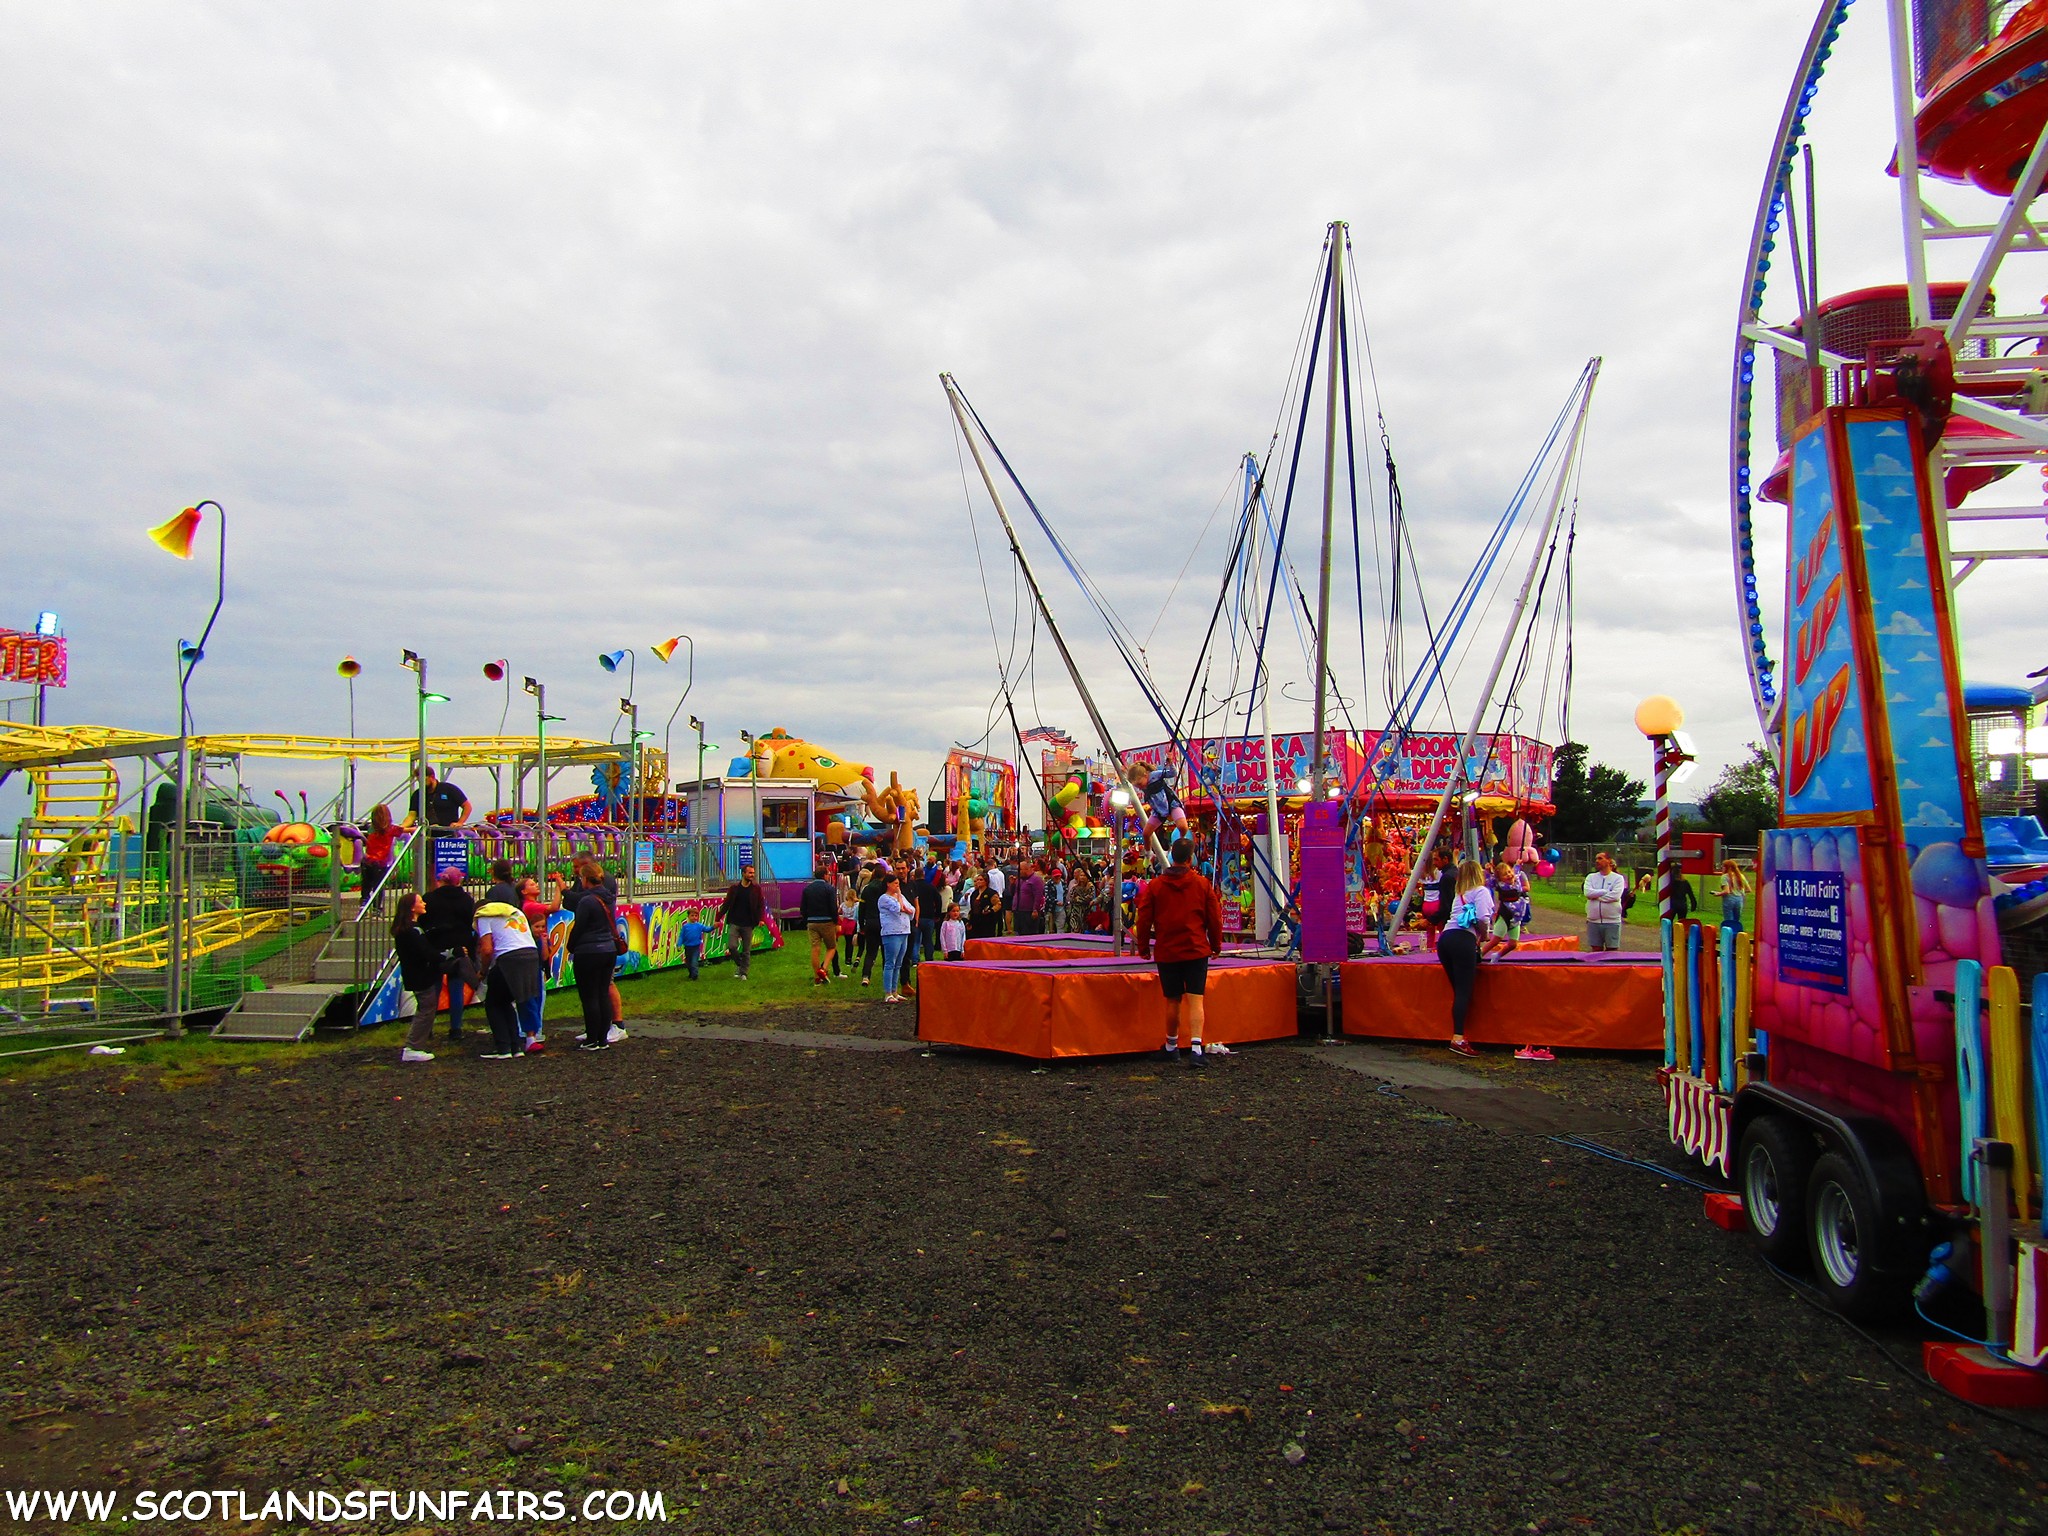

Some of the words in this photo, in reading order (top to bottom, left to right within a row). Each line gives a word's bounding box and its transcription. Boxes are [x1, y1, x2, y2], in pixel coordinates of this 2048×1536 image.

[1796, 509, 1832, 608] UP
[1795, 572, 1843, 686] UP
[1789, 662, 1849, 797] UP
[1225, 737, 1286, 762] HOOK
[1287, 736, 1306, 757] A
[1402, 735, 1457, 758] HOOK
[1236, 759, 1296, 783] DUK
[1779, 879, 1784, 896] L
[1785, 879, 1792, 897] &
[1793, 880, 1800, 897] B
[1801, 880, 1817, 898] Fun
[1818, 880, 1840, 899] Fairs
[1781, 905, 1791, 915] Like
[1791, 908, 1798, 916] us
[1798, 908, 1804, 916] on
[1818, 928, 1842, 940] CATERING
